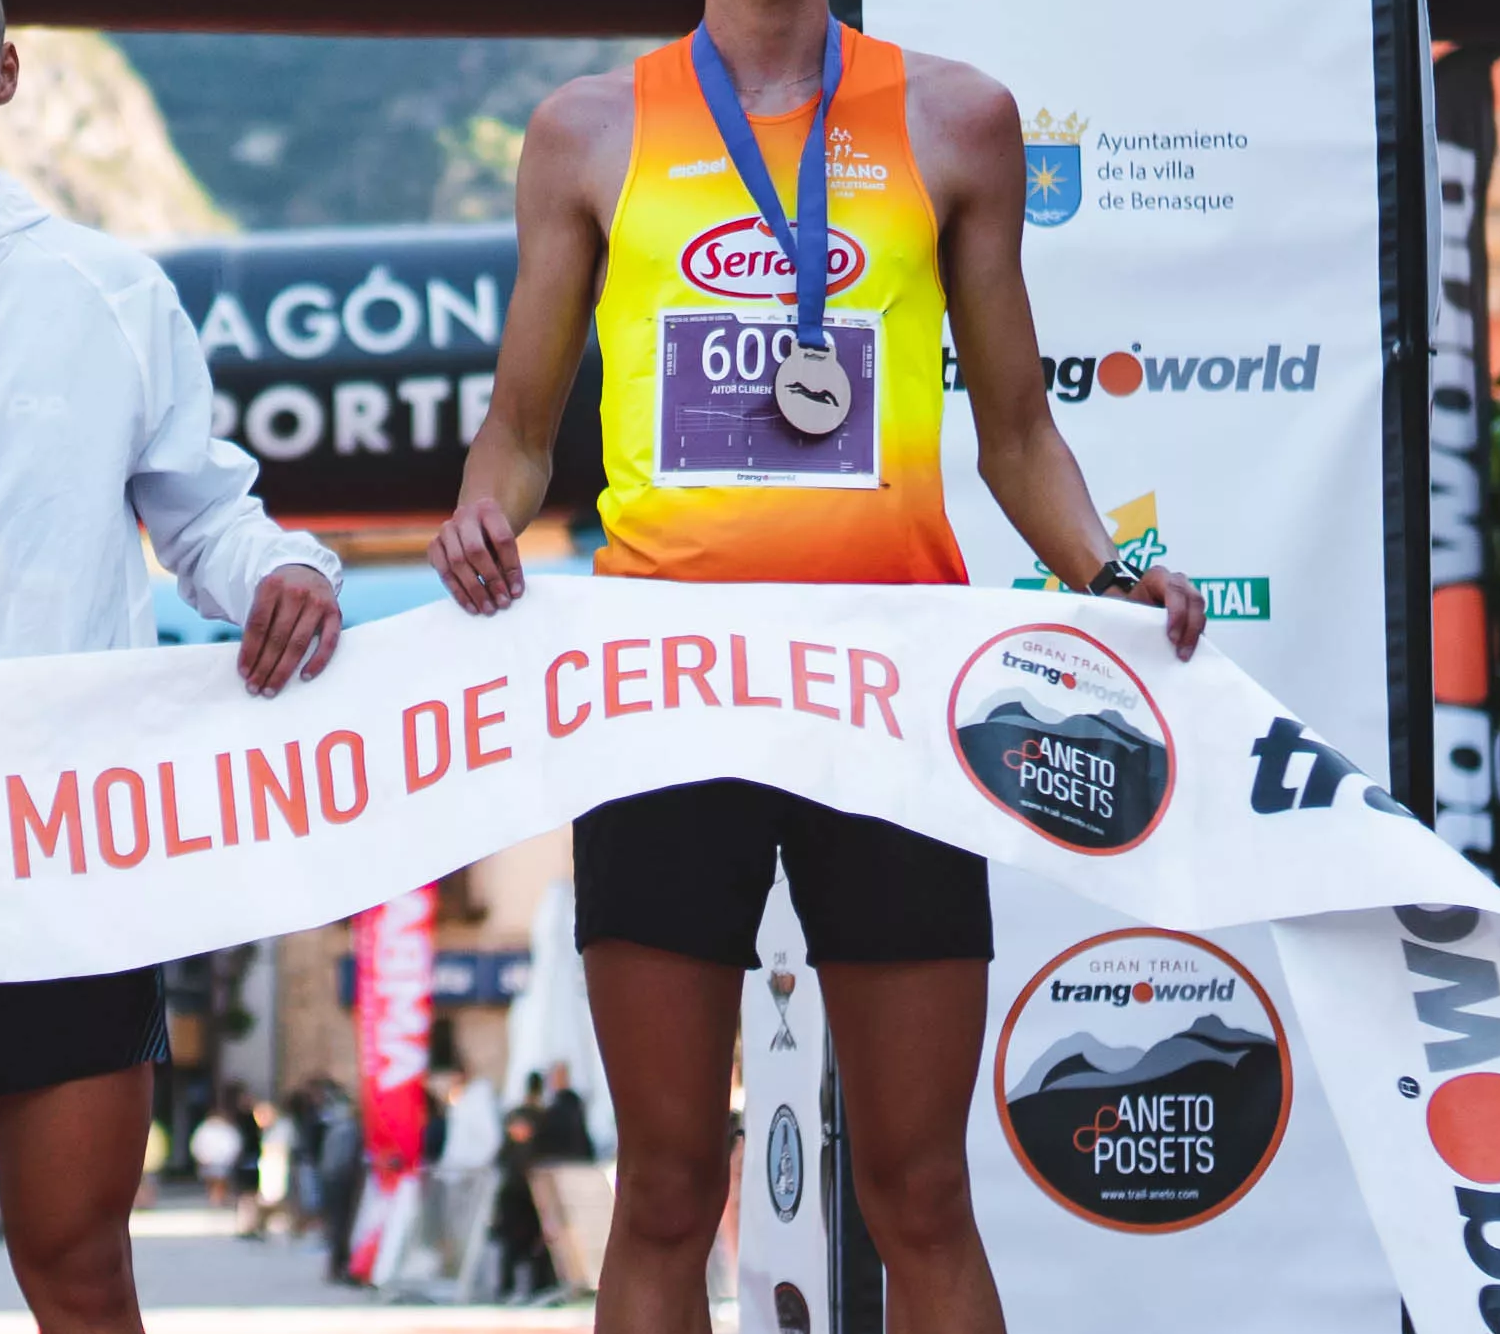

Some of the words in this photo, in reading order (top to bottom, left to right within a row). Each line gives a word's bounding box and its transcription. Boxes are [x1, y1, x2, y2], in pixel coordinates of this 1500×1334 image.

[1096, 129, 1248, 153] Ayuntamiento
[1097, 161, 1124, 181] de
[1129, 161, 1148, 181] la
[1152, 160, 1195, 181] villa
[1098, 191, 1125, 210] de
[1131, 191, 1234, 214] Benasque
[701, 242, 849, 280] Serrao
[711, 384, 737, 395] AITOR
[1022, 638, 1064, 663] GRAN
[1070, 652, 1115, 679] TRAIL
[6, 729, 371, 880] MOLINO
[402, 675, 512, 795] DE
[544, 633, 904, 741] CERLER
[1039, 736, 1116, 788] ANETO
[1019, 760, 1115, 820] POSETS
[1089, 960, 1137, 973] GRAN
[1148, 960, 1199, 973] TRAIL
[1050, 976, 1235, 1007] trangoworld
[1116, 1094, 1214, 1133] ANETO
[1093, 1135, 1215, 1176] POSETS
[1100, 1187, 1199, 1202] www.trail-aneto.com
